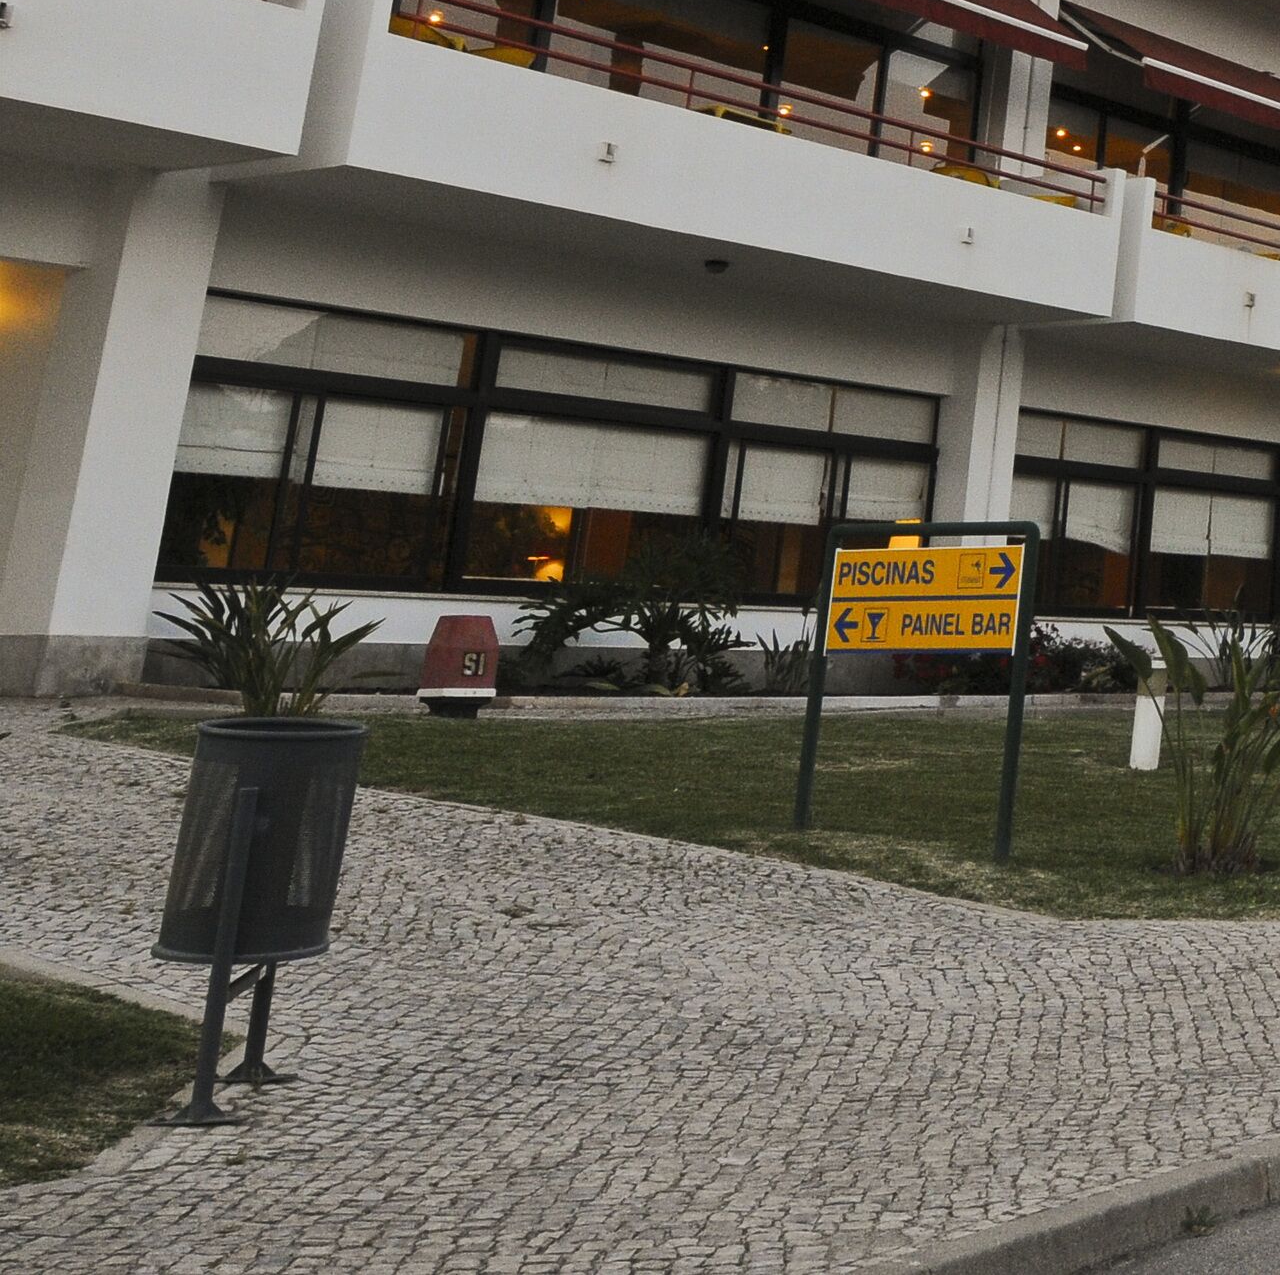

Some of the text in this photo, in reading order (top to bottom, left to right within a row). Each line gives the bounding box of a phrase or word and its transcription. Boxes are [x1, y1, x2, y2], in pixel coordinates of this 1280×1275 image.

[838, 560, 935, 585] PISCINAS
[901, 612, 1011, 636] PAINEL BAR
